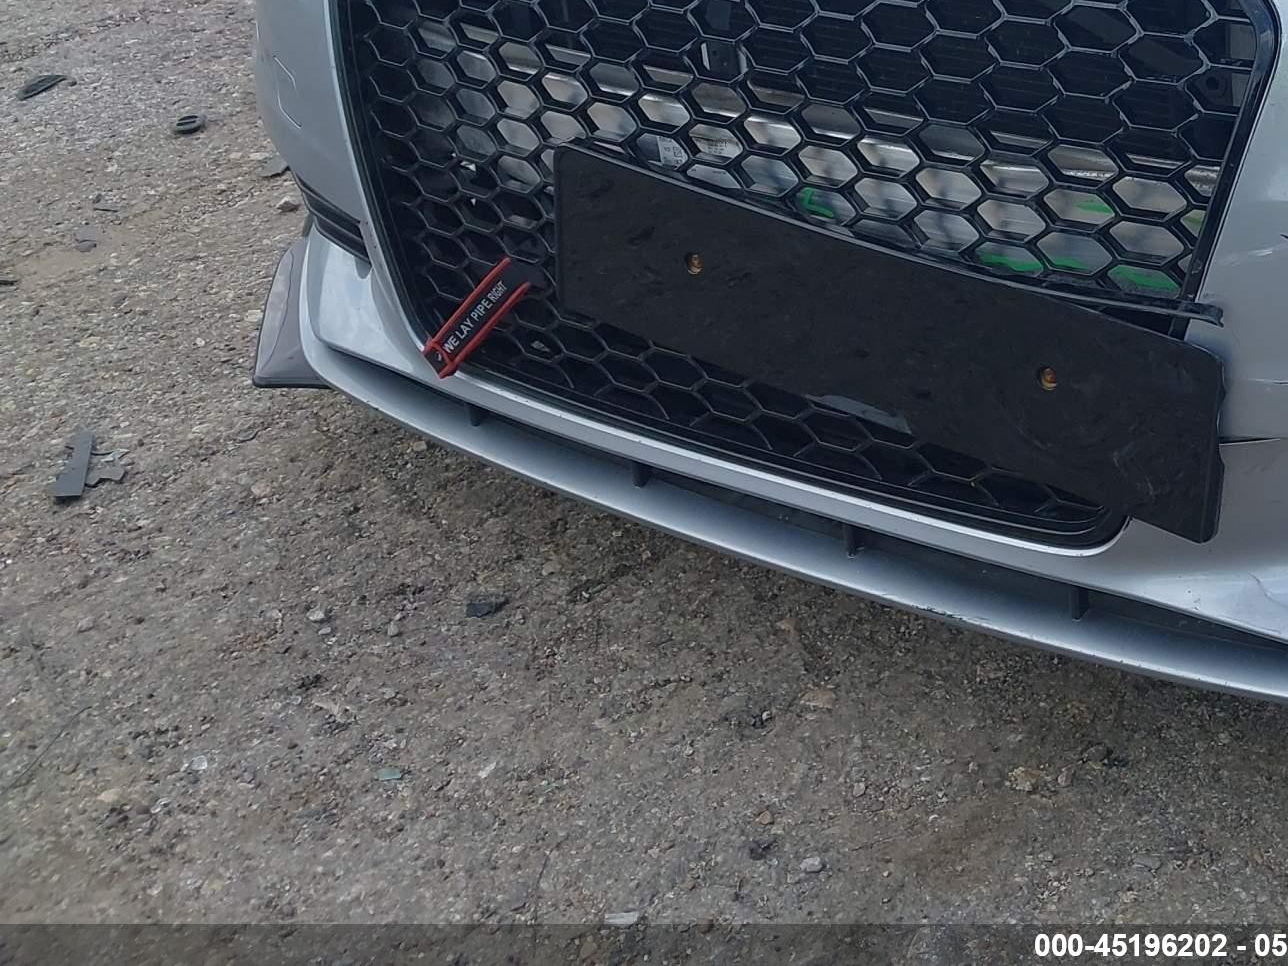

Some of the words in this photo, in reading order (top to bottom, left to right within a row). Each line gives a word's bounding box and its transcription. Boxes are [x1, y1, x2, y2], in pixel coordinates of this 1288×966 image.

[442, 335, 460, 354] WE
[455, 317, 475, 340] LAY
[470, 298, 493, 322] PIPE
[487, 280, 508, 303] RIGHT
